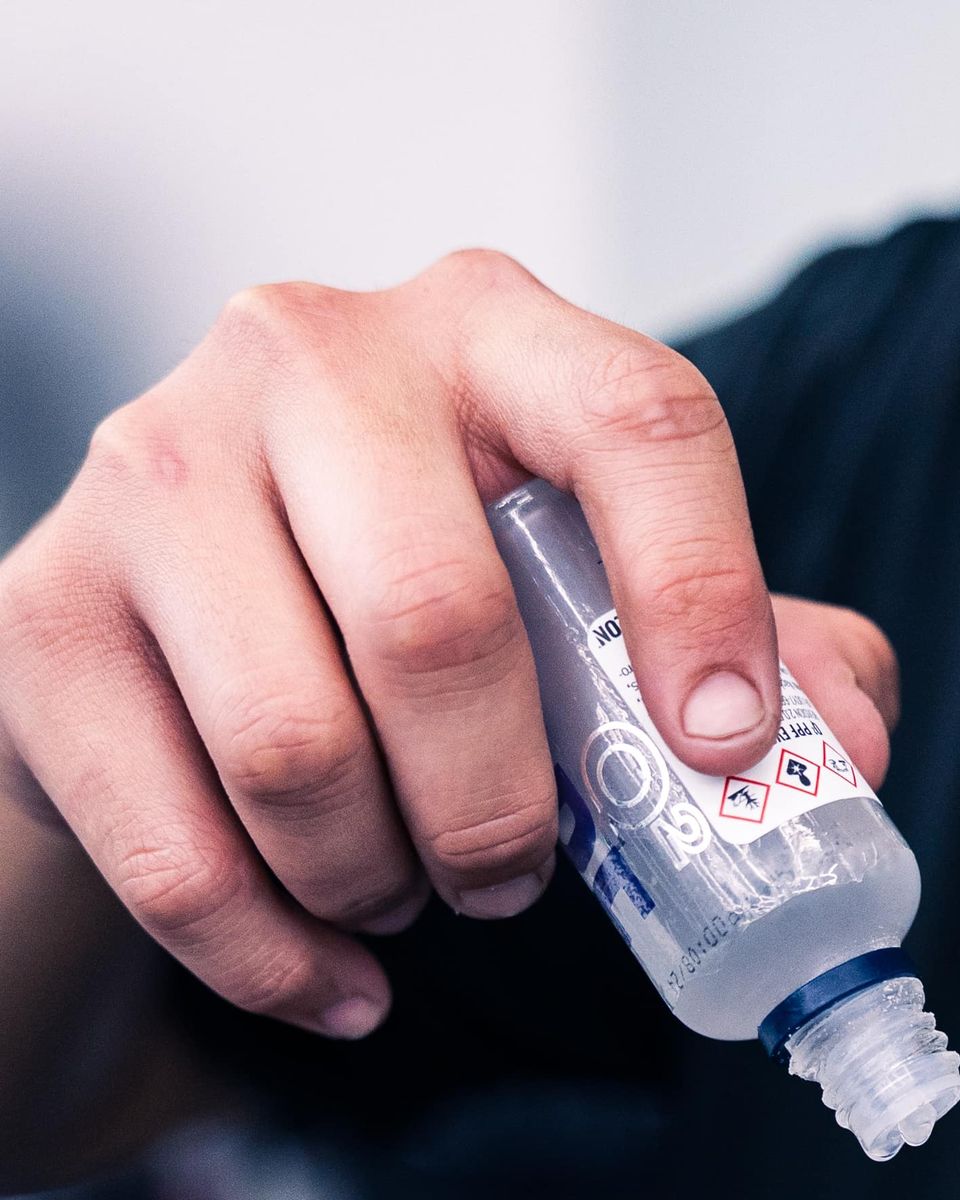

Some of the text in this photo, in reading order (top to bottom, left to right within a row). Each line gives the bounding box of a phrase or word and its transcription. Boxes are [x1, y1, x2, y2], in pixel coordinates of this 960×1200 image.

[592, 615, 622, 647] ON
[776, 726, 791, 743] EV
[789, 721, 813, 739] PPF
